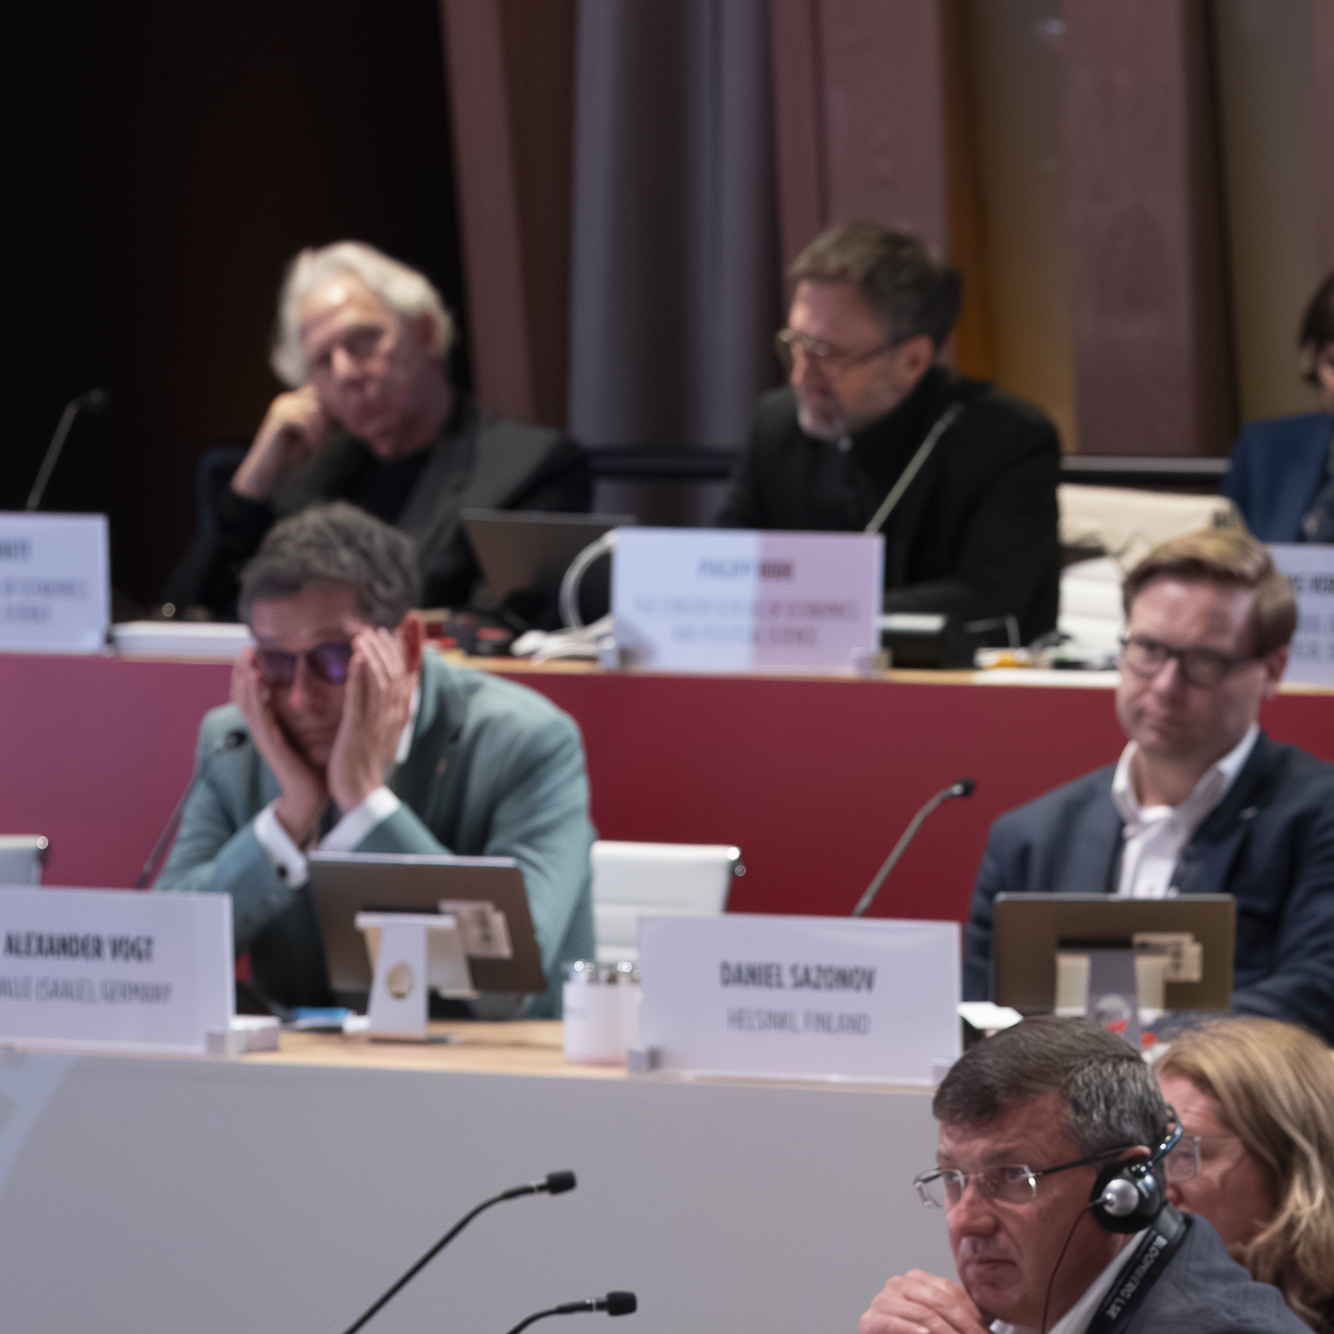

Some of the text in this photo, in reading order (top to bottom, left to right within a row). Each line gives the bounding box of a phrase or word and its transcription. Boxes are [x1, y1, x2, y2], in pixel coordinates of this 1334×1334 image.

[3, 931, 154, 963] ALEXANDER VOGT
[720, 961, 877, 992] DANIEL SAZONOV
[99, 980, 173, 1004] GERMANY
[803, 1010, 871, 1036] FINLAND
